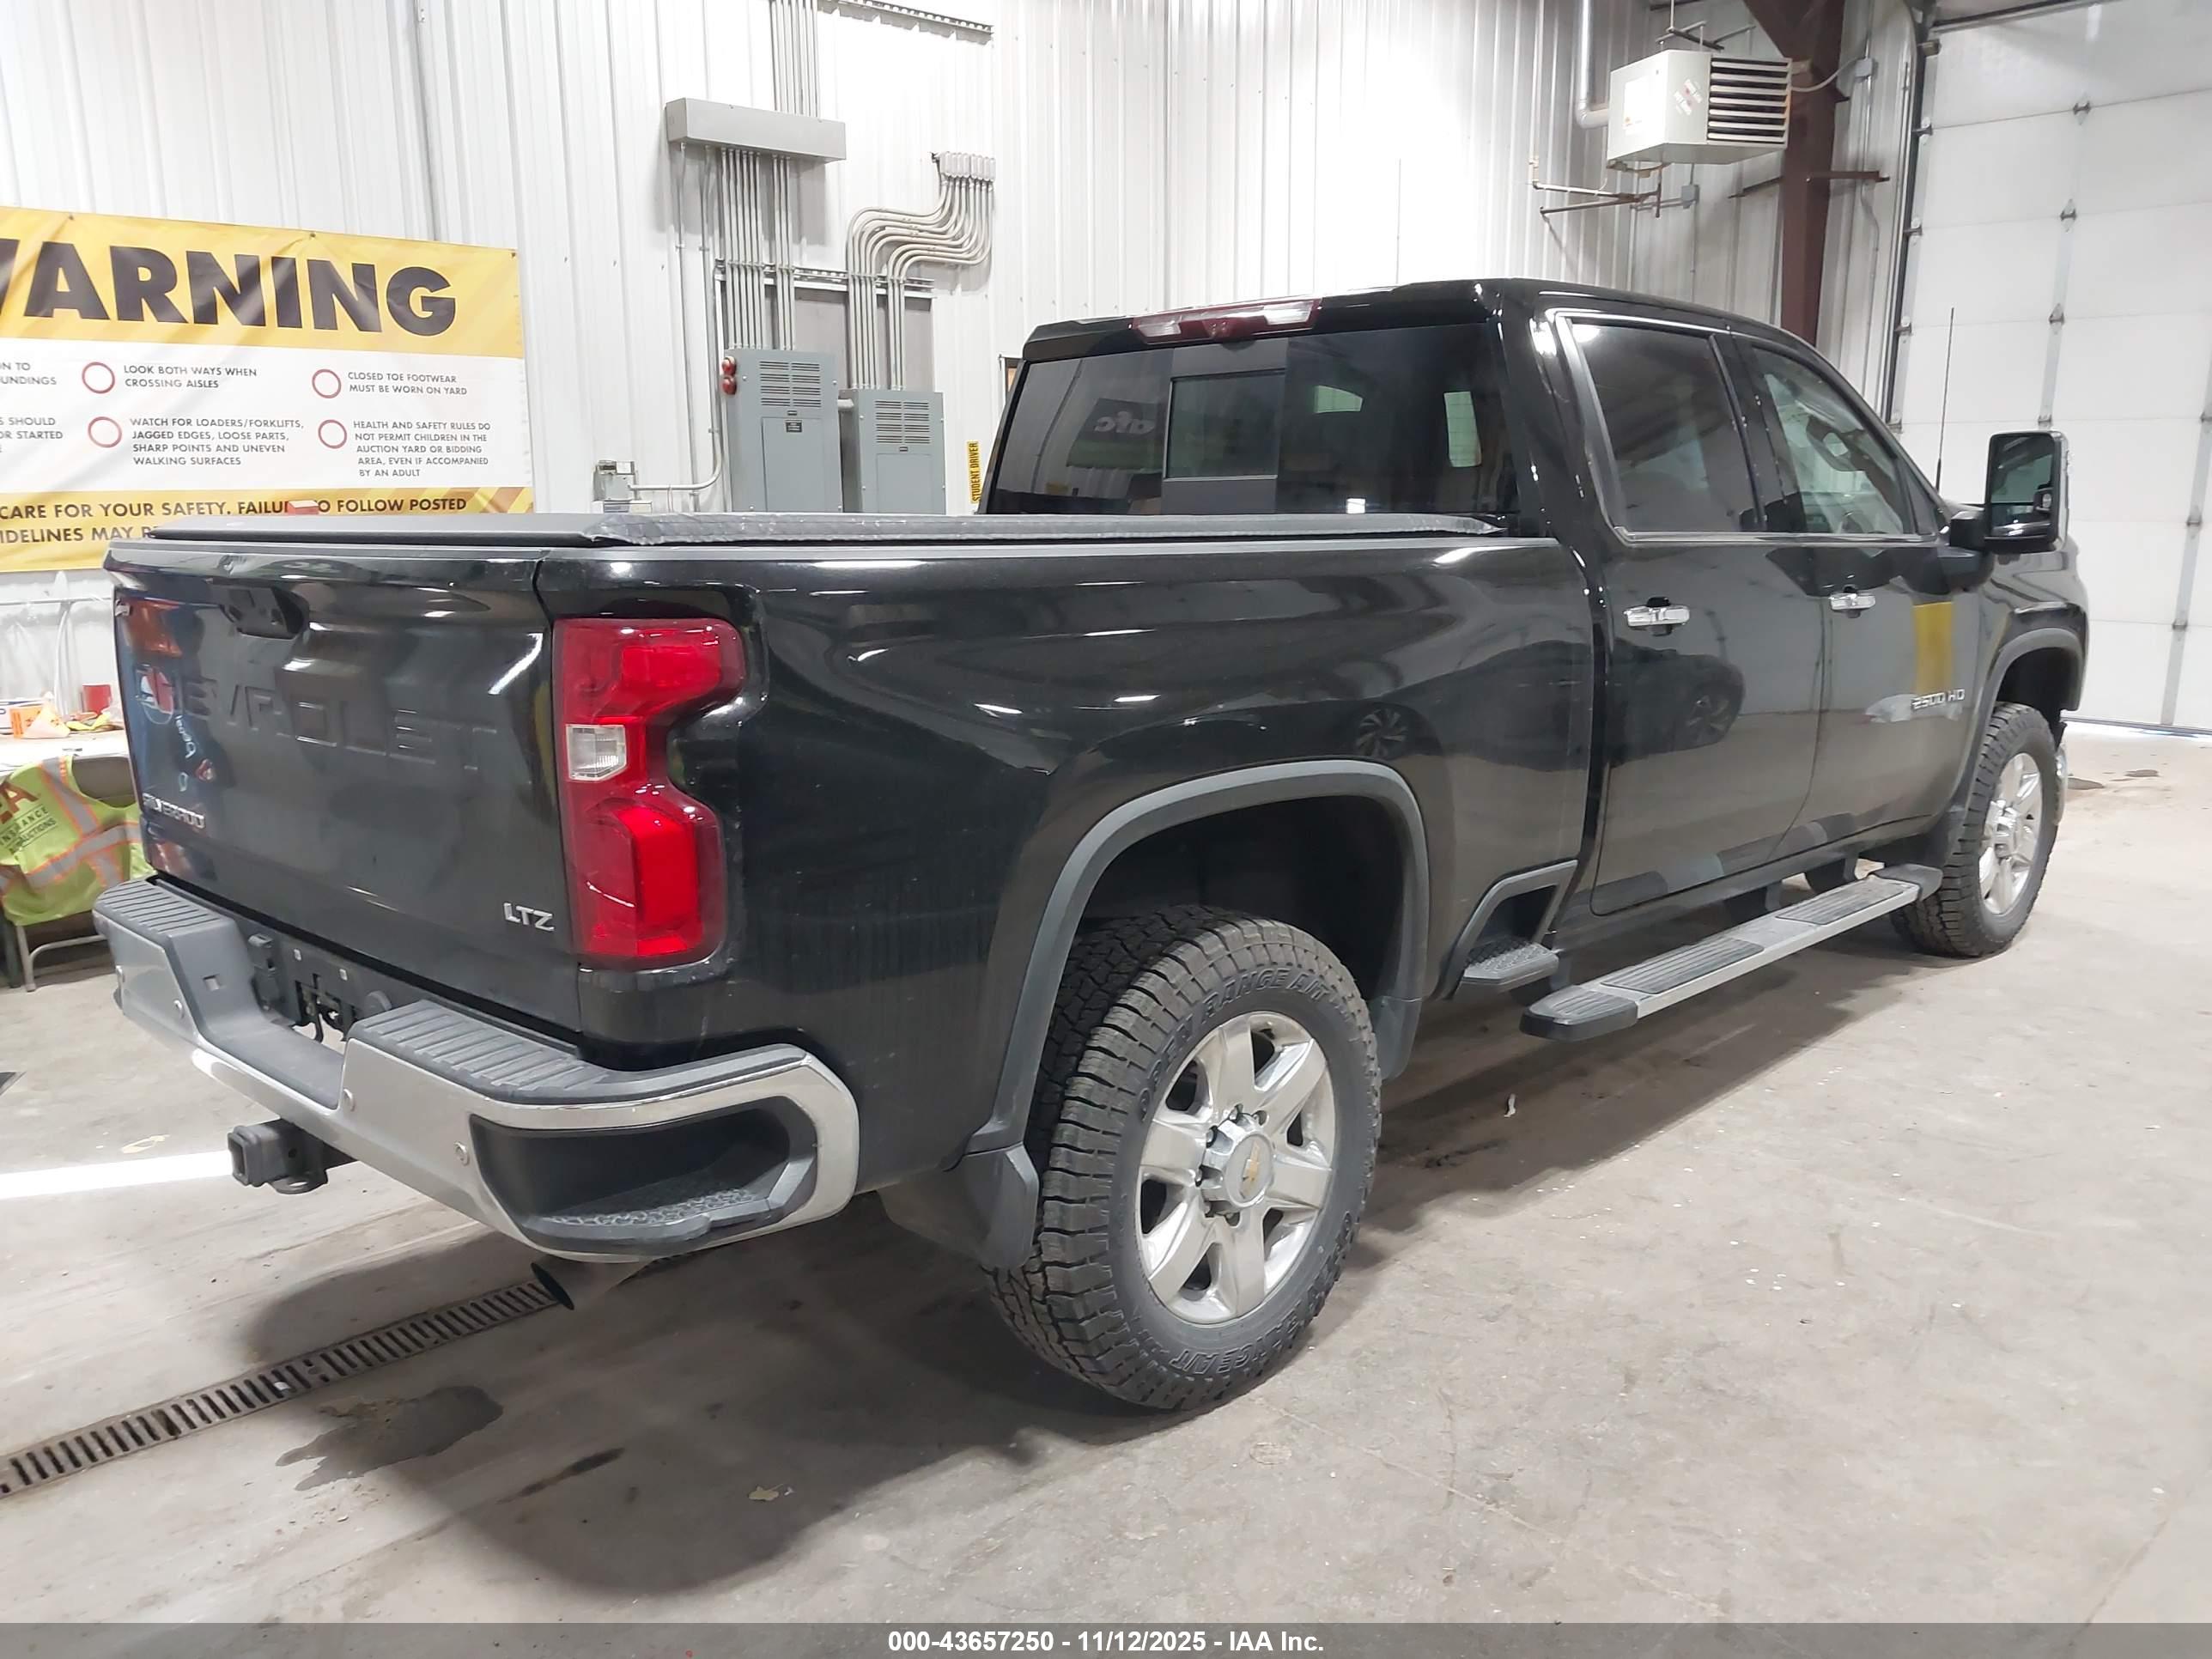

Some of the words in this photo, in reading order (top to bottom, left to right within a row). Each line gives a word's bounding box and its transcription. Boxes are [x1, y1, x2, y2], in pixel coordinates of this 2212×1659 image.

[0, 239, 456, 337] ARNING
[15, 362, 31, 371] TO
[124, 365, 155, 374] LOOK
[158, 366, 188, 375] BOTH
[191, 367, 222, 376] WAYS
[225, 368, 258, 377] WHEN
[348, 372, 384, 380] CLOSED
[386, 373, 404, 381] TOE
[407, 374, 457, 383] FOOTWEAR
[125, 379, 183, 387] CROSSING
[186, 380, 219, 388] AISLES
[349, 384, 375, 392] MUST
[379, 385, 390, 393] BE
[392, 386, 423, 394] WORN
[443, 386, 468, 395] YARD
[9, 417, 56, 426] SHOULD
[130, 418, 168, 427] WATCH
[172, 418, 192, 427] FOR
[196, 418, 304, 428] LOADERS/FORKLIFTS,
[392, 421, 413, 429] AND
[17, 430, 63, 440] STARTED
[132, 431, 174, 440] JAGGED
[178, 431, 215, 441] EDGES,
[218, 432, 252, 441] LOOSE
[255, 432, 289, 441] PARTS,
[355, 433, 374, 441] NOT
[379, 433, 410, 441] PERMIT
[133, 444, 168, 453] SHARP
[172, 444, 212, 453] POINTS
[969, 442, 979, 468] DRIVER
[133, 457, 187, 465] WALKING
[190, 457, 241, 465] SURFACES
[971, 471, 981, 501] STUDENT
[0, 505, 46, 520] CARE
[55, 504, 93, 518] FOR
[99, 502, 155, 517] YOUR
[161, 501, 231, 516] SAFETY.
[238, 501, 289, 514] FAILU
[337, 499, 404, 513] FOLLOW
[409, 498, 467, 511] POSTED
[91, 526, 134, 541] MAY
[1911, 692, 1945, 709] 2500
[1948, 689, 1966, 702] HD
[503, 902, 555, 932] LTZ
[1203, 968, 1291, 1018] RANGE
